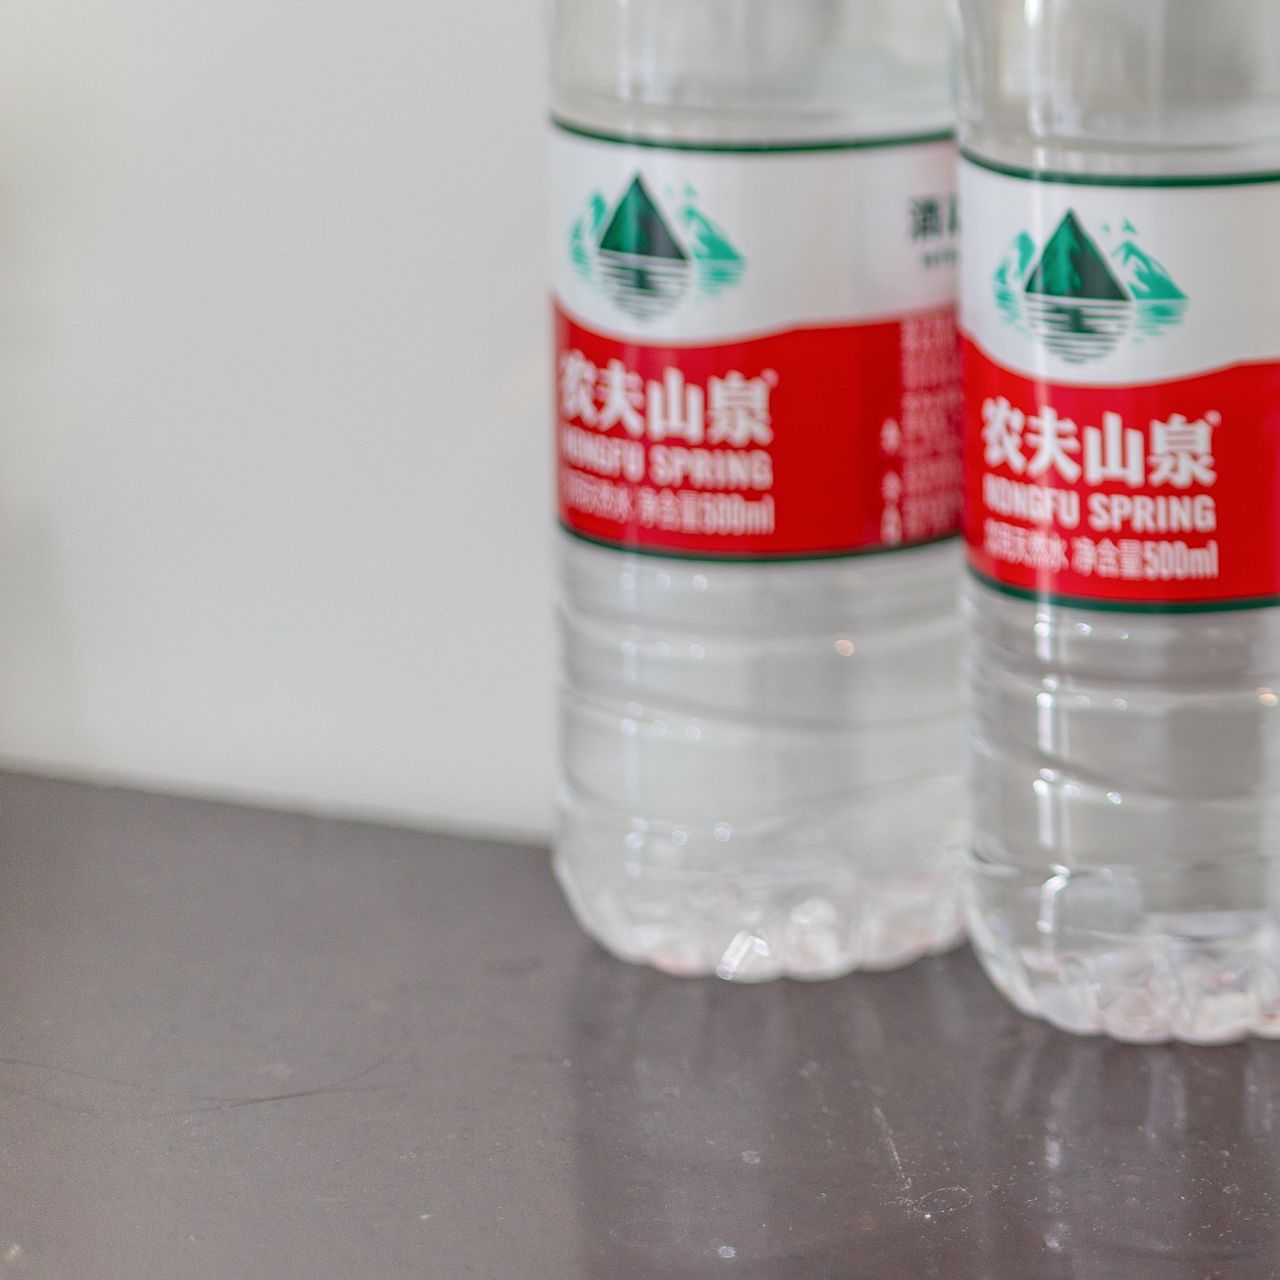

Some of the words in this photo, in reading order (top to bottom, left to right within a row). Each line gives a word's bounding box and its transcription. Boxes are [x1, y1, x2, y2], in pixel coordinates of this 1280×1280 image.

[561, 347, 774, 447] 农夫山泉
[650, 444, 774, 491] SPRING
[981, 396, 1218, 489] 农夫山泉
[982, 472, 1081, 529] NONGFU
[1087, 492, 1217, 533] SPRING
[1071, 536, 1219, 581] 净含量500ml
